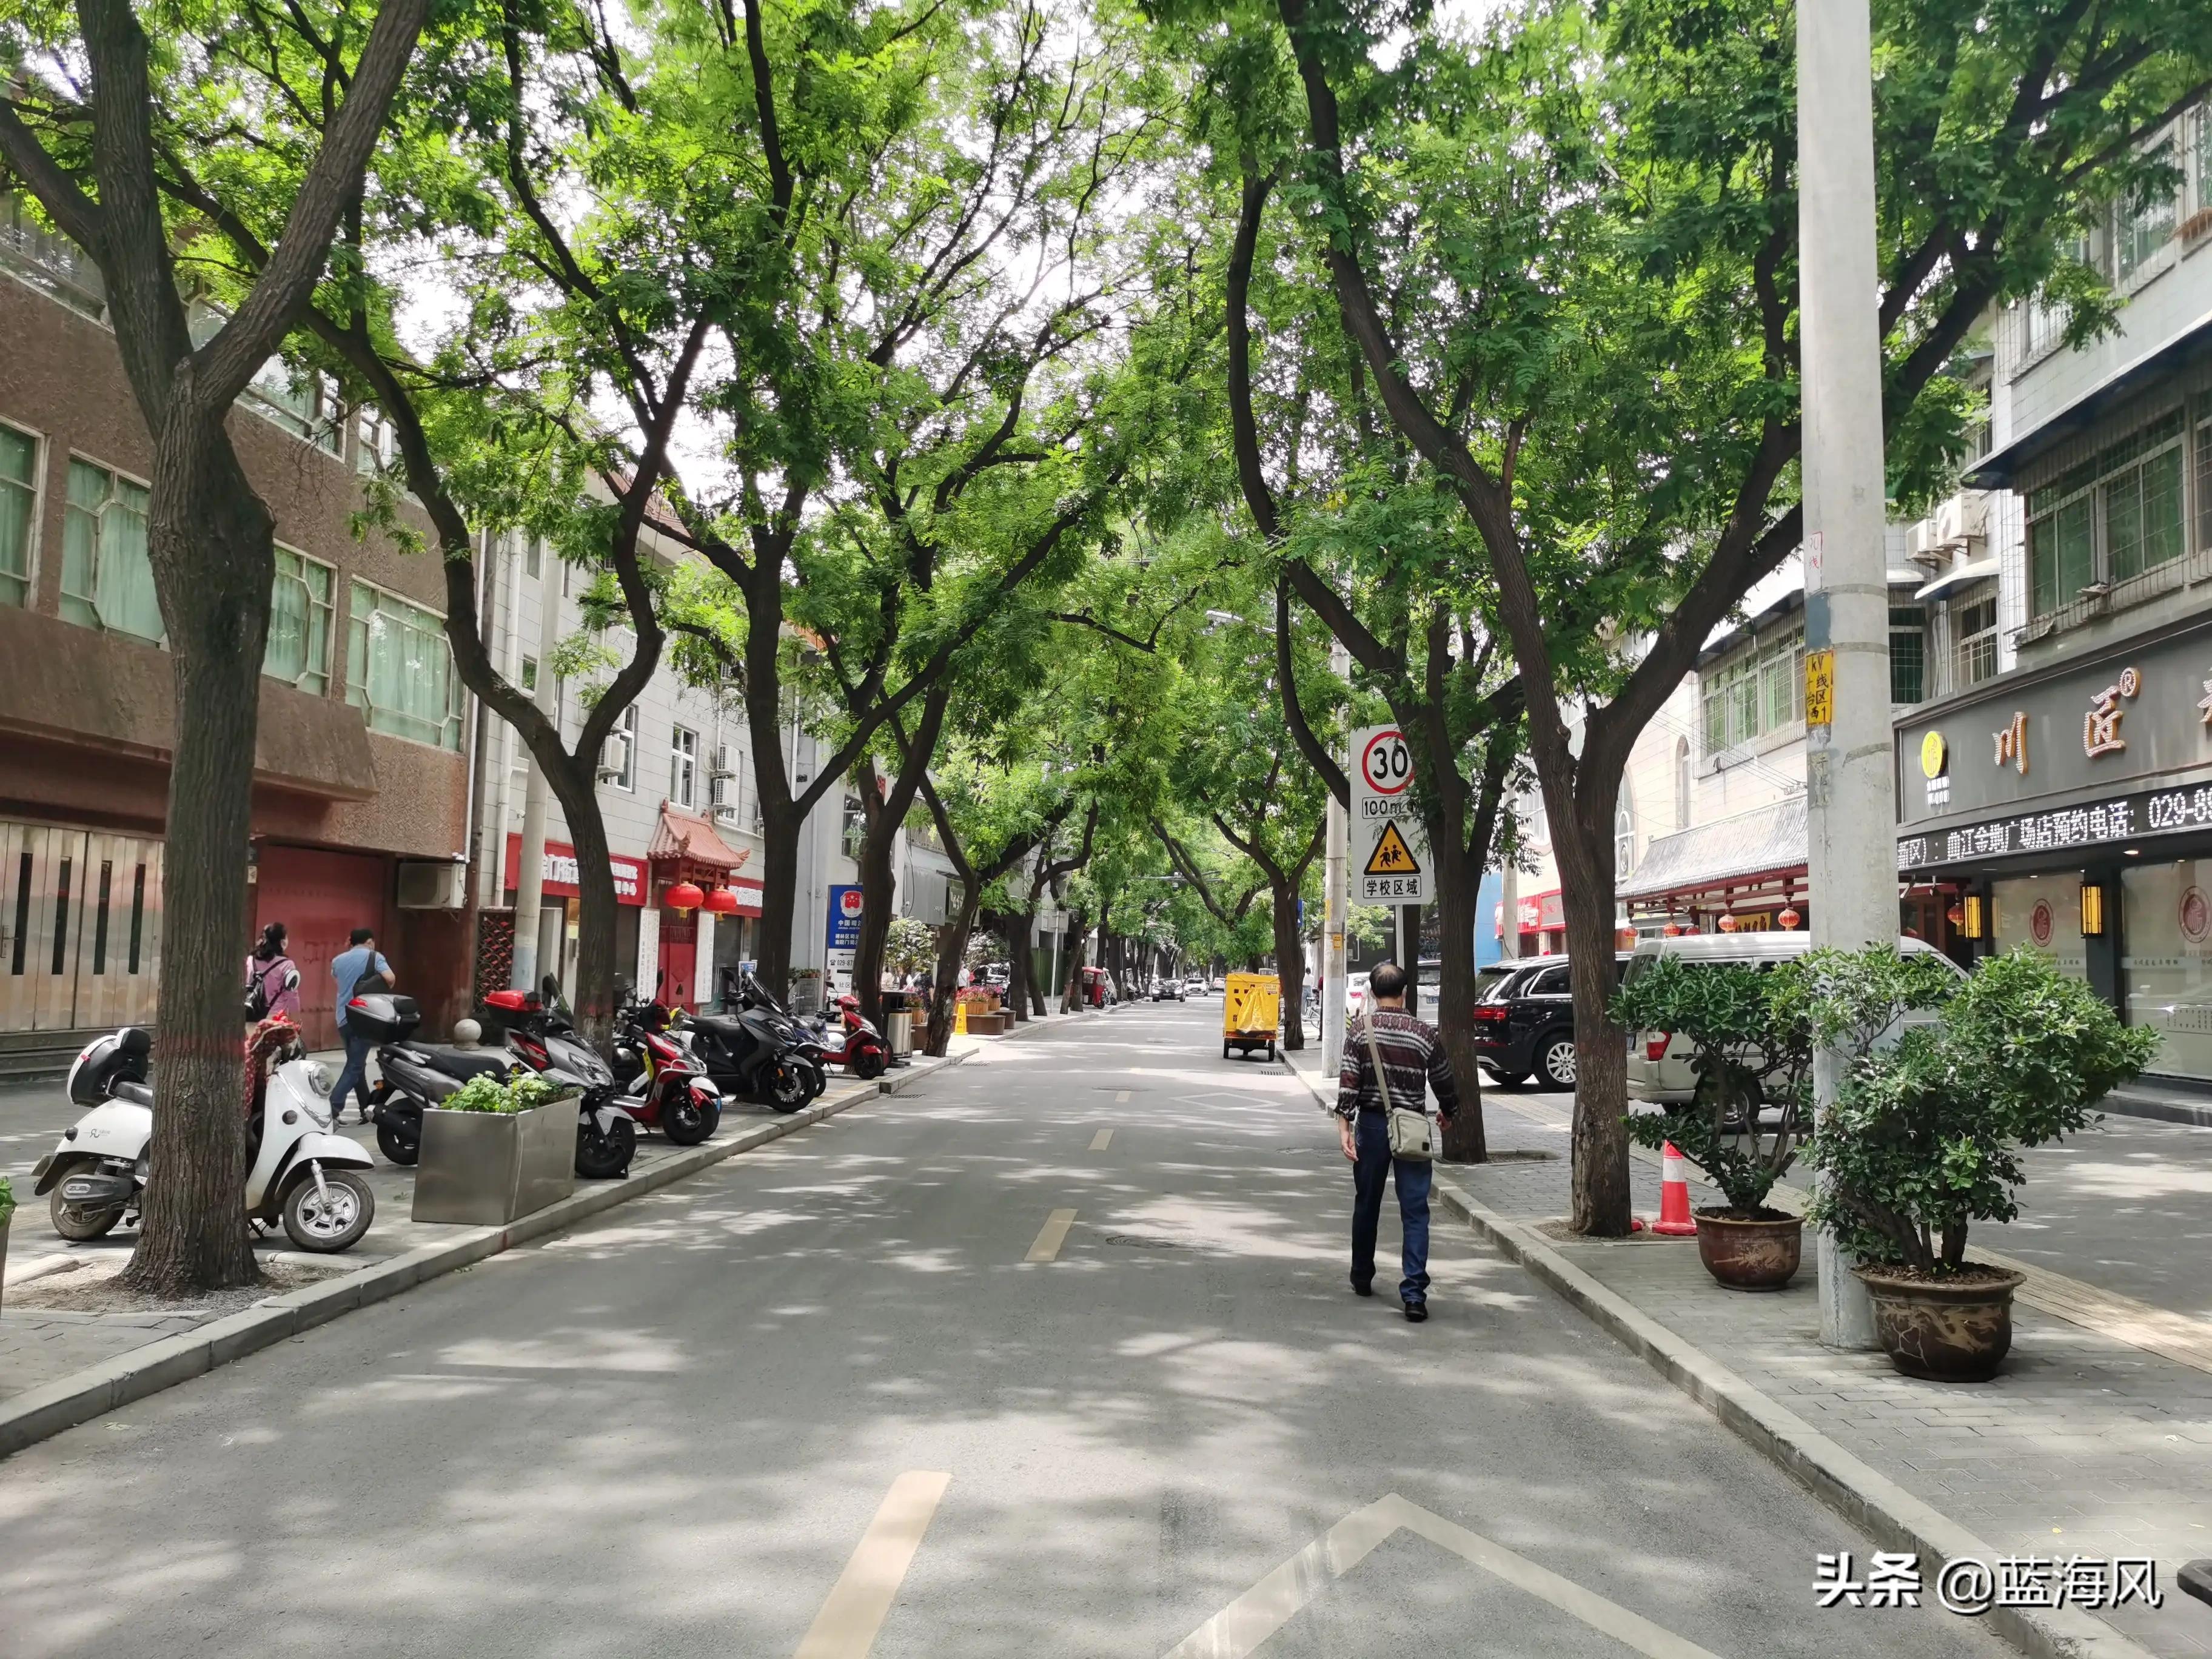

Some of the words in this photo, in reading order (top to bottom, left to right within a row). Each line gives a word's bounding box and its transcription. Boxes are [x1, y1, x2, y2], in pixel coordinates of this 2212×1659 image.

[1372, 745, 1408, 779] 30
[1366, 879, 1418, 896] 学校区域
